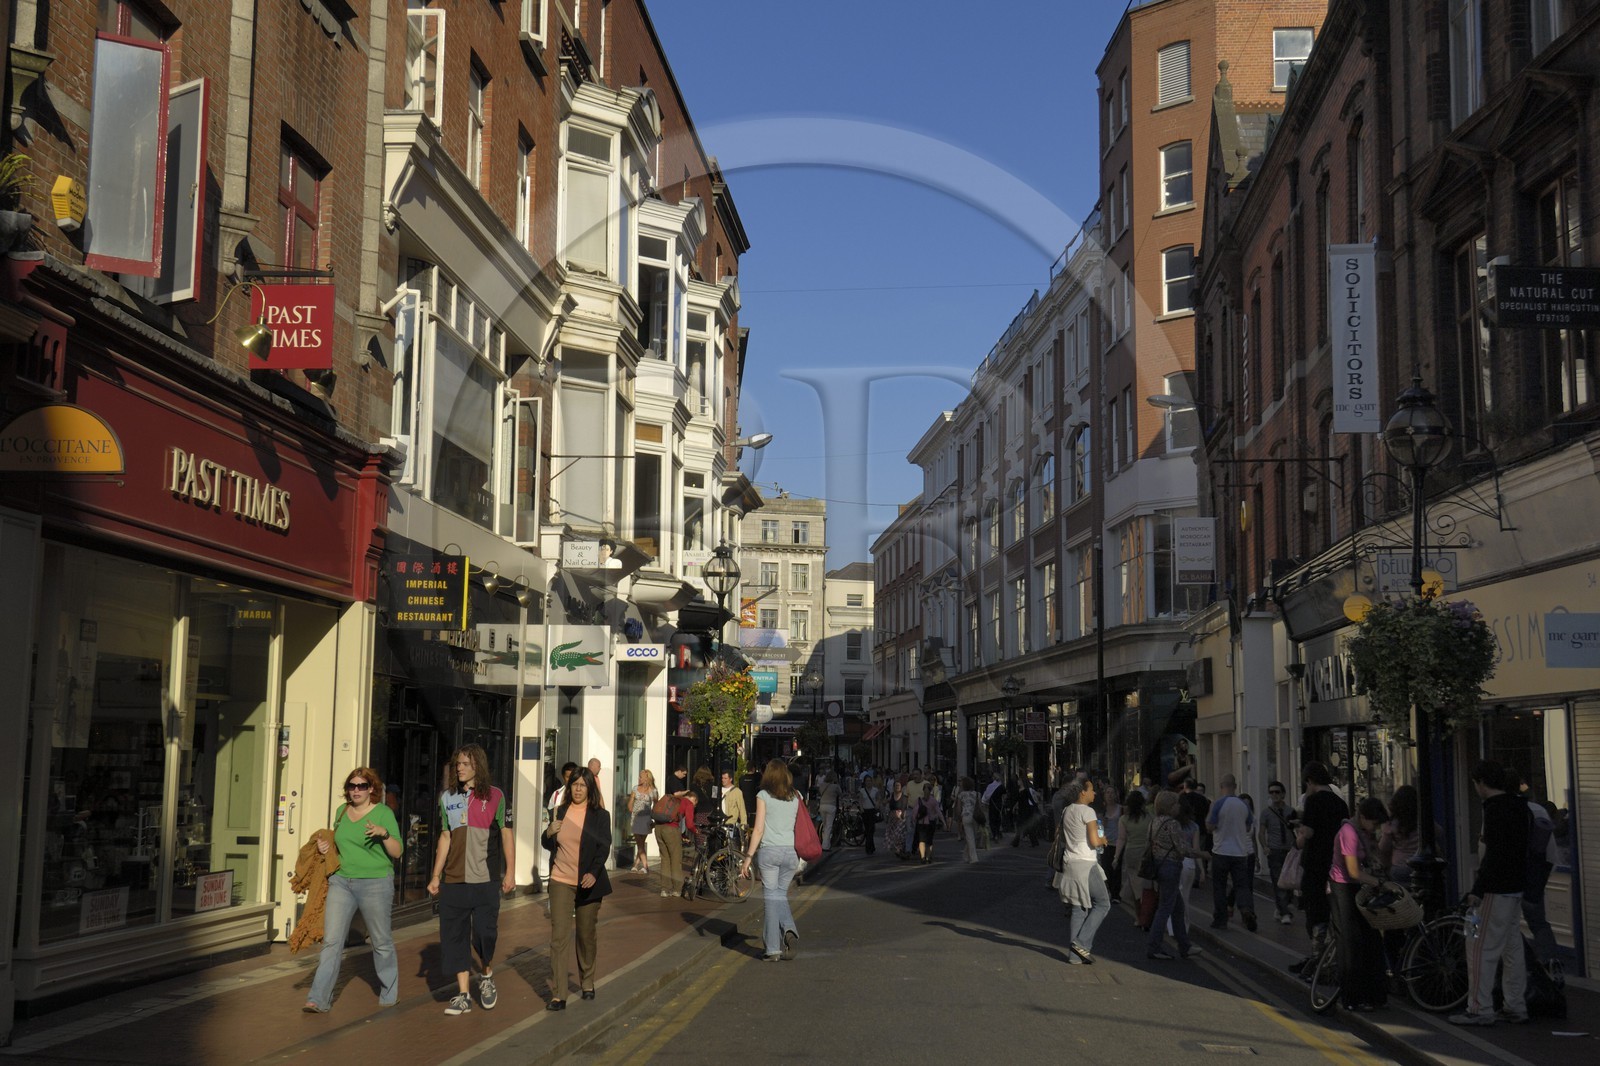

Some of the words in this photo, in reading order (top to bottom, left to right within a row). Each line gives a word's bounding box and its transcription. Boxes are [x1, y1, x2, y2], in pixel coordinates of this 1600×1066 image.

[1540, 273, 1563, 285] THE
[1509, 287, 1566, 299] NATURAL
[1571, 288, 1595, 300] CUT
[1499, 302, 1548, 311] SPECIALIST
[267, 305, 317, 325] PAST
[1345, 258, 1363, 400] SOLICITORS
[270, 329, 322, 348] IMES
[1354, 403, 1376, 417] garr
[19, 456, 32, 464] EN
[37, 456, 92, 464] PROVENCE
[169, 446, 227, 507] PAST
[230, 470, 291, 531] TIMES
[570, 544, 593, 552] Beauty
[406, 580, 448, 589] IMPERIAL
[408, 596, 445, 605] CHINESE
[397, 612, 453, 621] RESTAURANT
[1549, 632, 1566, 640] mc
[626, 647, 659, 658] ecco
[446, 802, 463, 811] NEC
